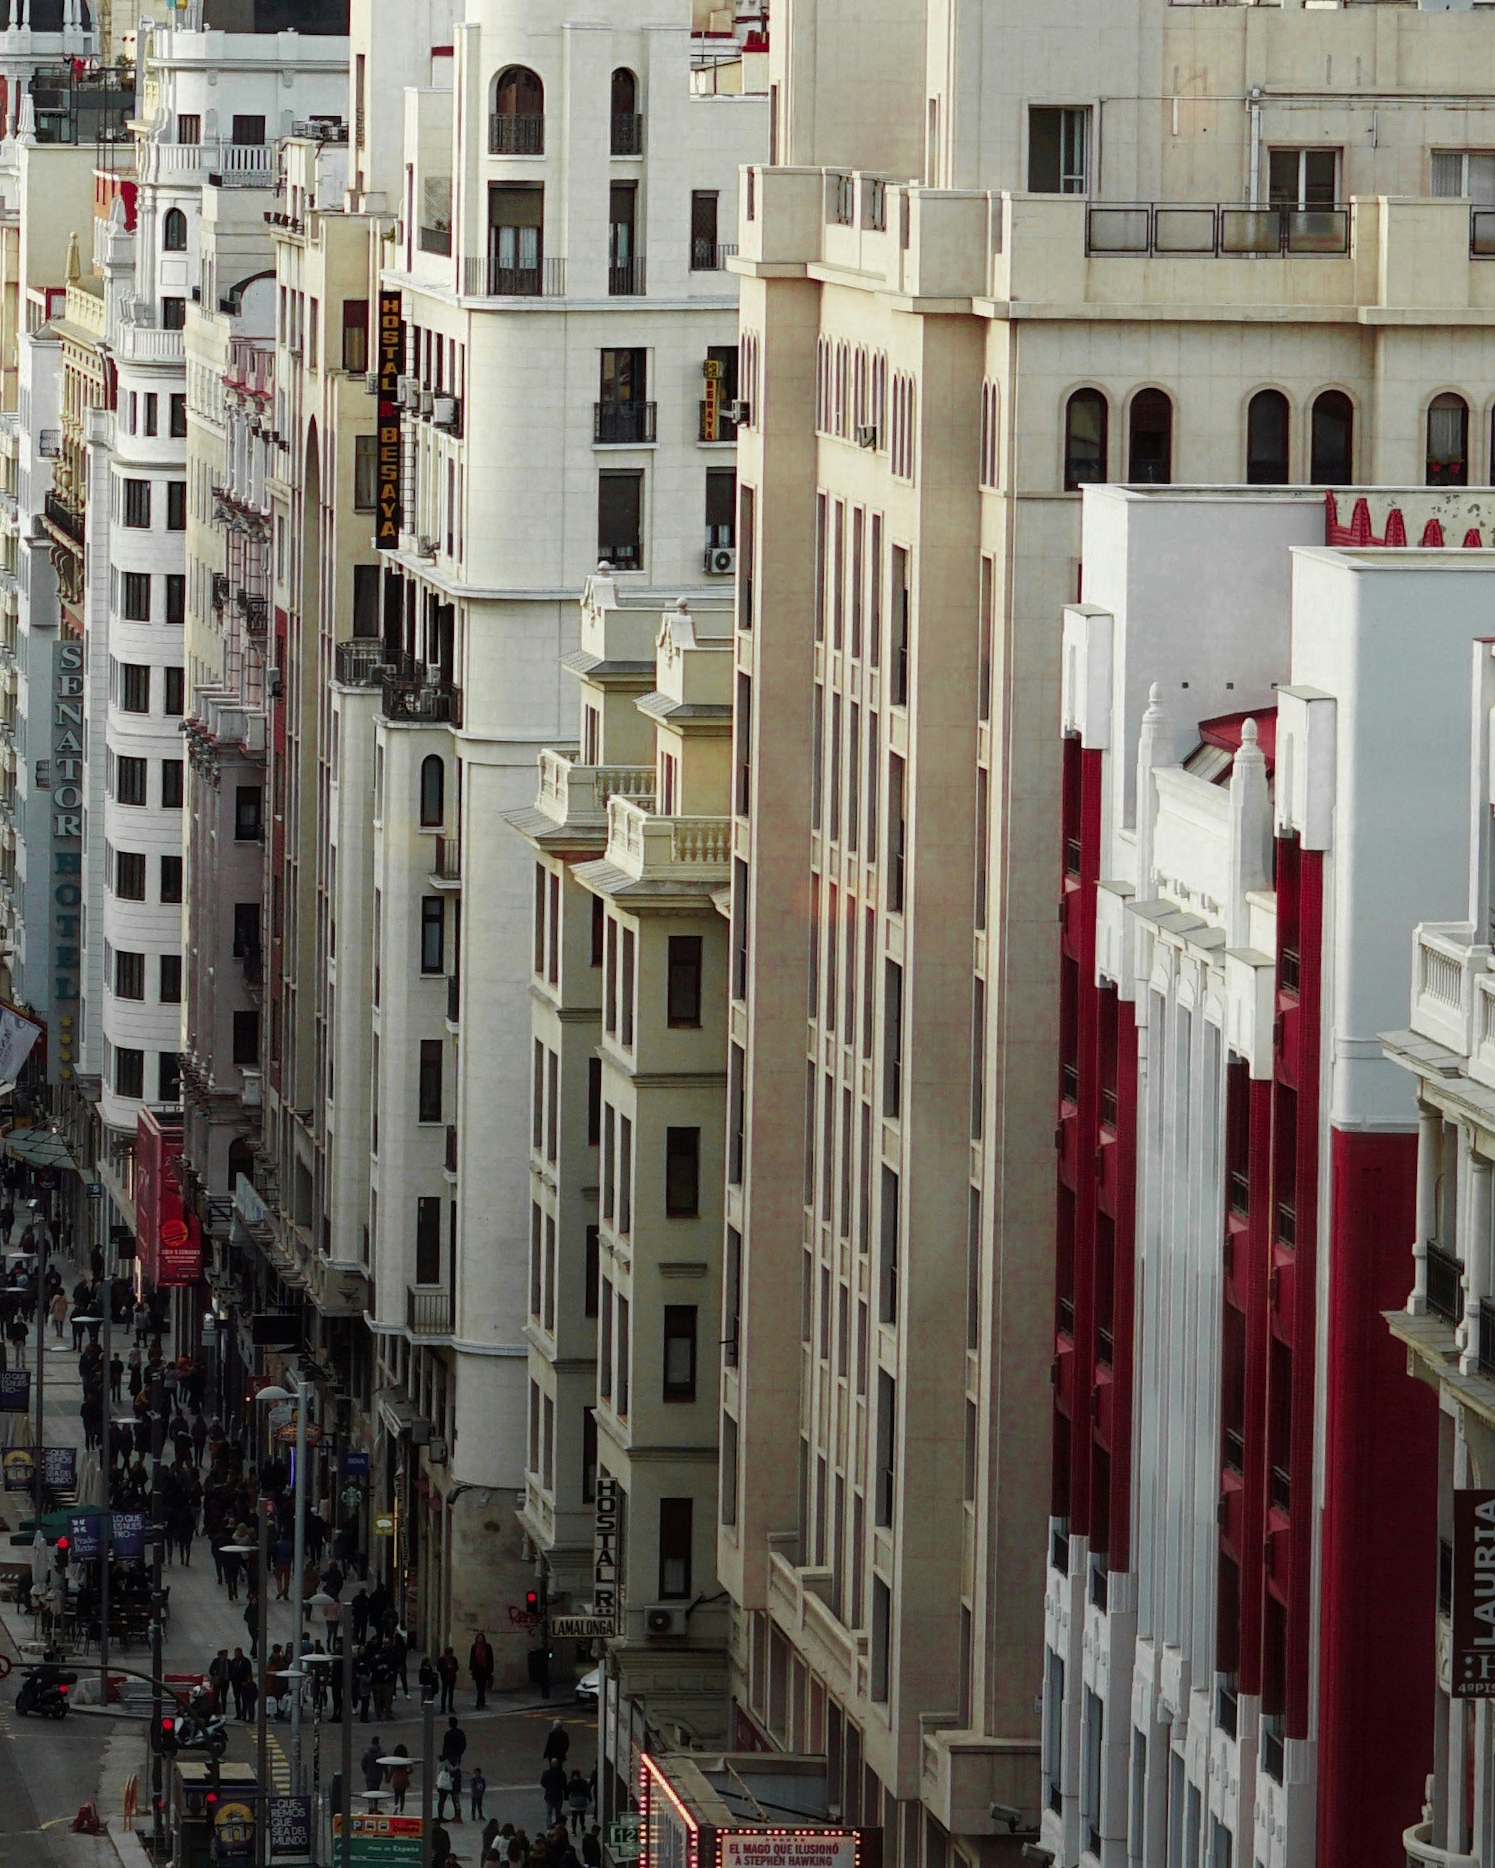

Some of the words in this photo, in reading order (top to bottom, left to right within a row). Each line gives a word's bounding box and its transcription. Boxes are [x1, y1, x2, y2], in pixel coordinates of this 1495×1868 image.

[381, 299, 399, 390] HOSTAL
[380, 427, 398, 537] BESAYA
[54, 646, 83, 837] SENATOR
[55, 852, 81, 1001] HOTEL
[595, 1479, 616, 1583] HOSTAL
[552, 1619, 614, 1636] LAMALONGA
[271, 1808, 306, 1817] REMOS
[271, 1817, 293, 1827] QUE
[271, 1827, 290, 1836] SEA
[292, 1827, 307, 1836] DEL
[272, 1836, 308, 1845] MUNDO
[729, 1844, 740, 1854] EL
[743, 1844, 771, 1854] MAGO
[773, 1844, 793, 1855] QUE
[795, 1843, 839, 1854] ILUSIONÓ
[735, 1856, 743, 1865] A
[744, 1856, 786, 1866] STEPHEN
[788, 1856, 832, 1866] HAWKING
